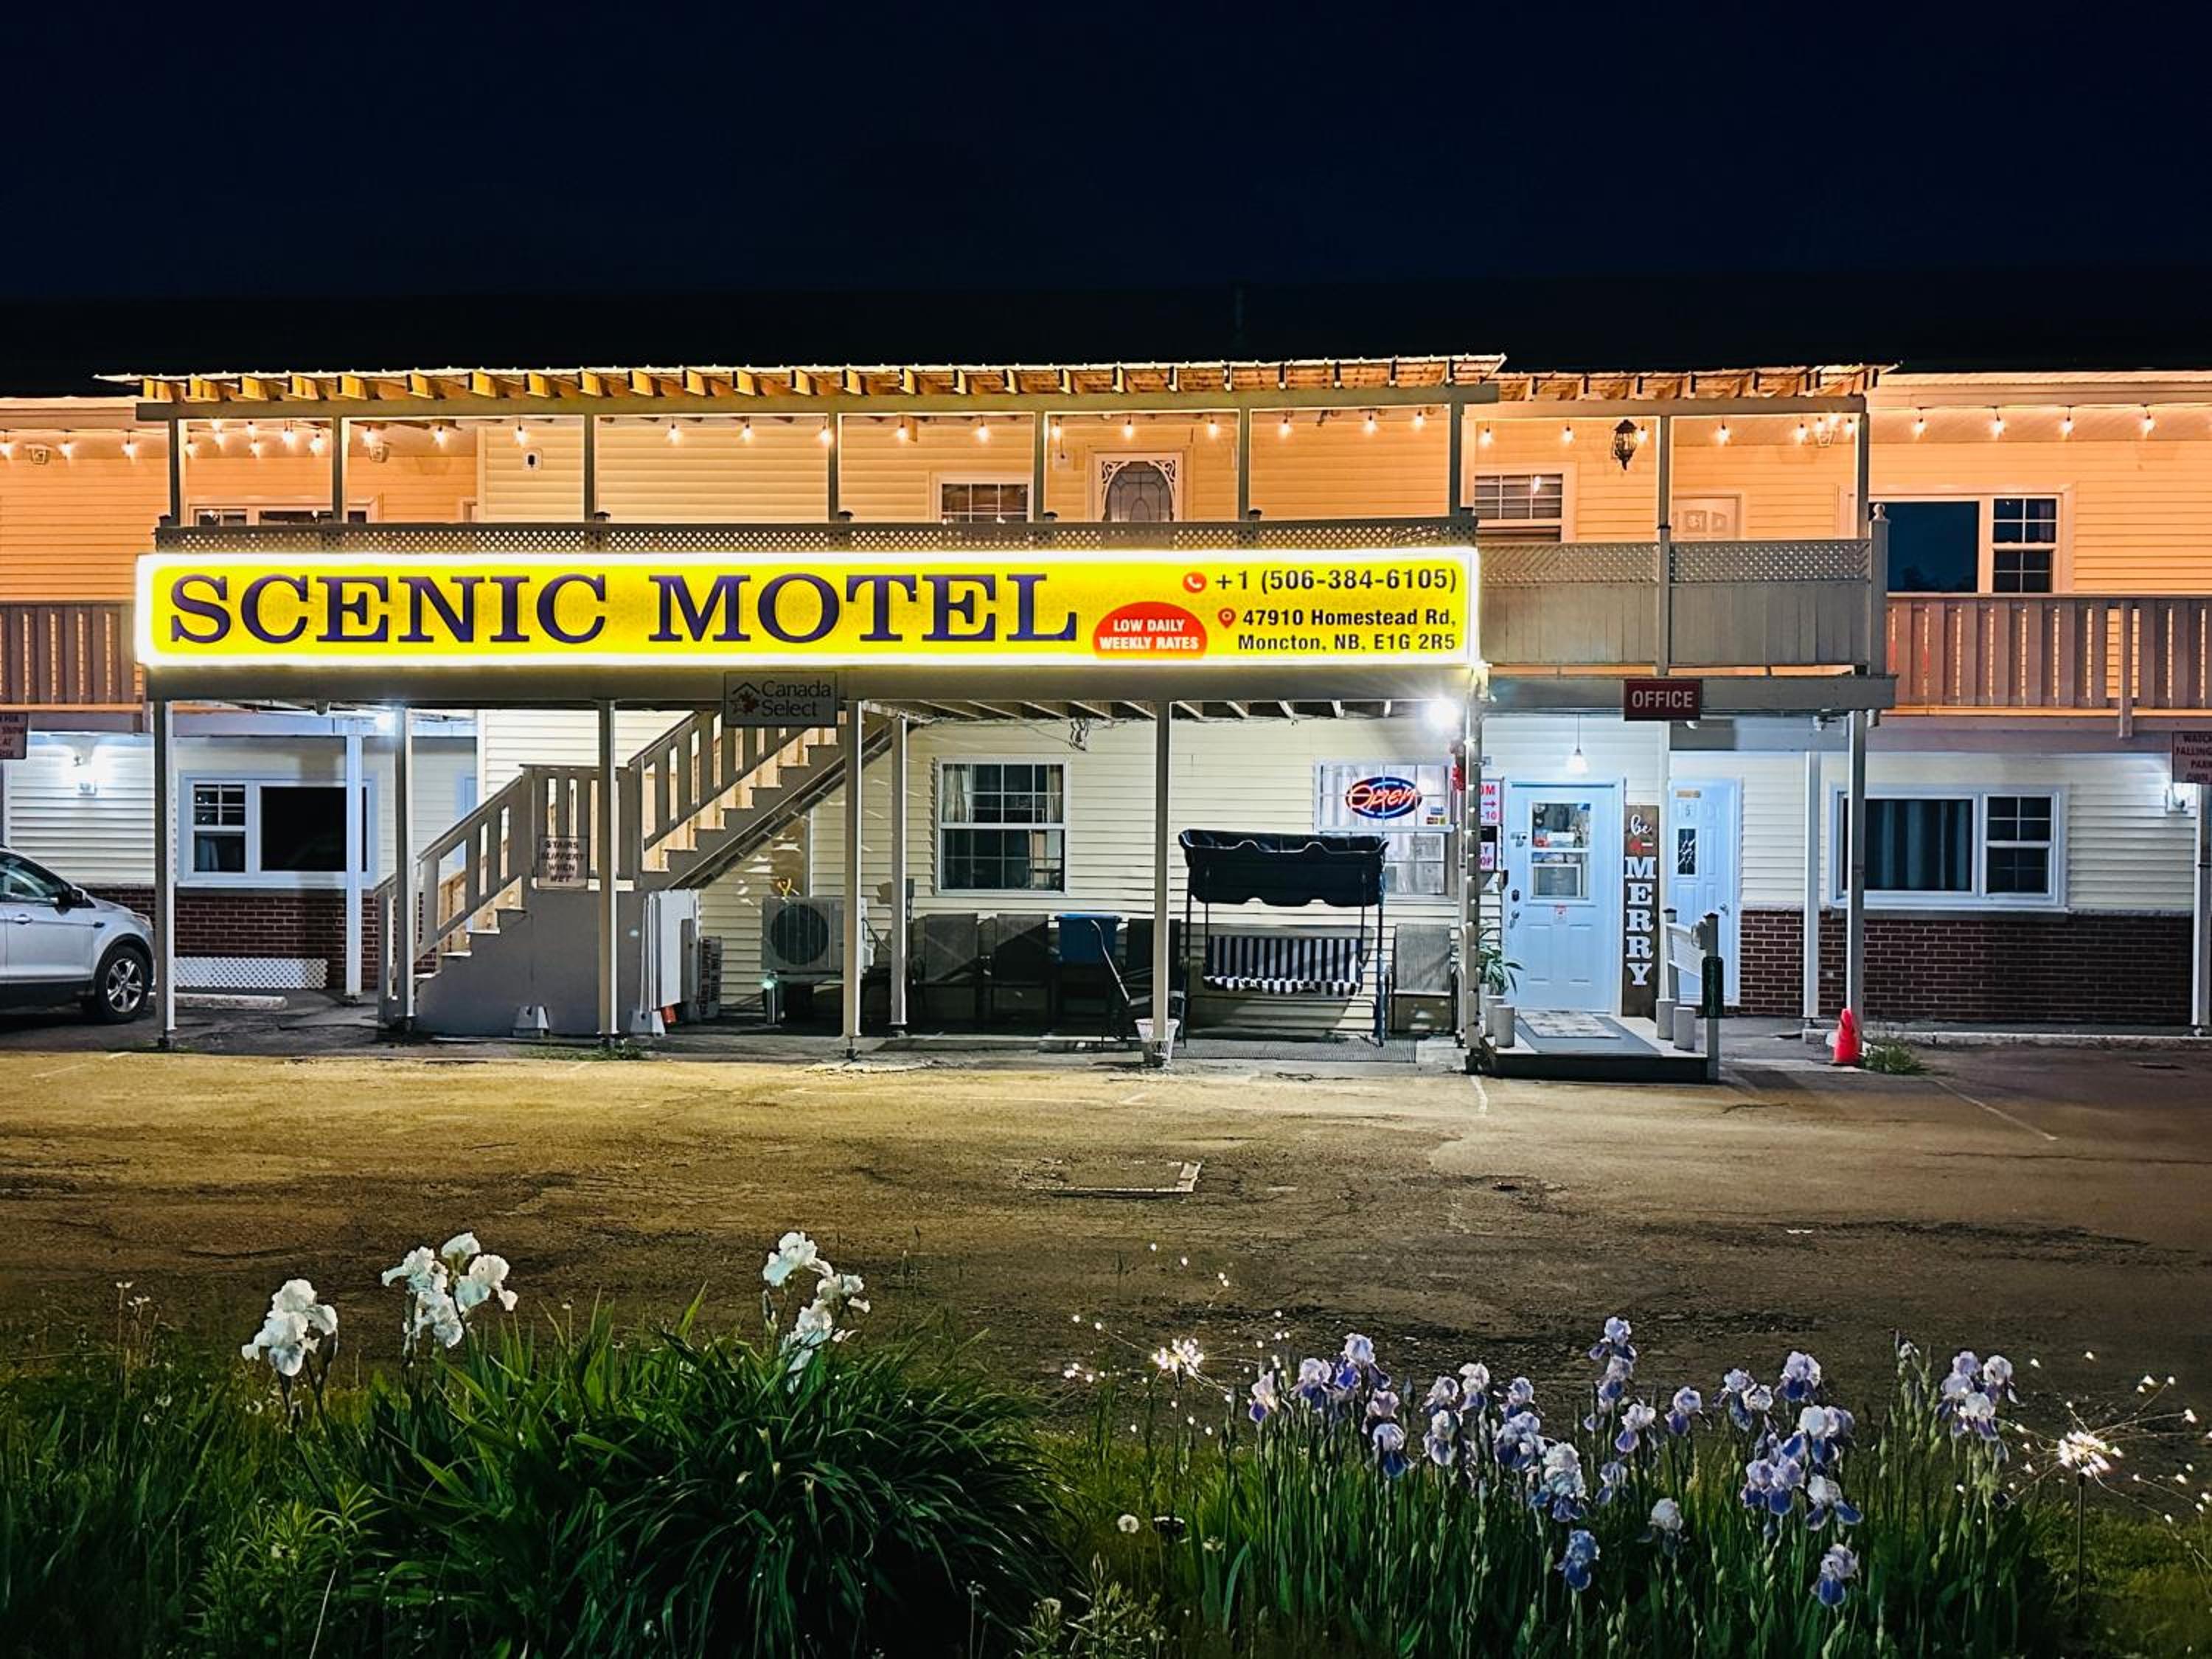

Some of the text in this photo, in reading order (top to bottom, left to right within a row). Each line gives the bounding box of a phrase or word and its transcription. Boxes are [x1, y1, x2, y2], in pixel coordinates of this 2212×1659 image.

[1215, 568, 1457, 594] +1 (506-384-6105)
[170, 572, 1077, 644] SCENIC MOTEL
[1113, 619, 1185, 632] LOW DAILY
[1242, 608, 1456, 628] 47910 Homestead Rd,
[1099, 636, 1199, 650] WEEKLY RATES
[1238, 633, 1327, 652] Moncton,
[1374, 633, 1411, 650] E1G
[1418, 633, 1455, 650] 2R5
[762, 680, 831, 698] Canada
[762, 700, 818, 717] Select
[1632, 690, 1694, 709] OFFICE
[2183, 735, 2212, 743] WATC
[1347, 783, 1418, 810] Open
[1630, 814, 1652, 836] be
[1624, 856, 1657, 987] MERRY
